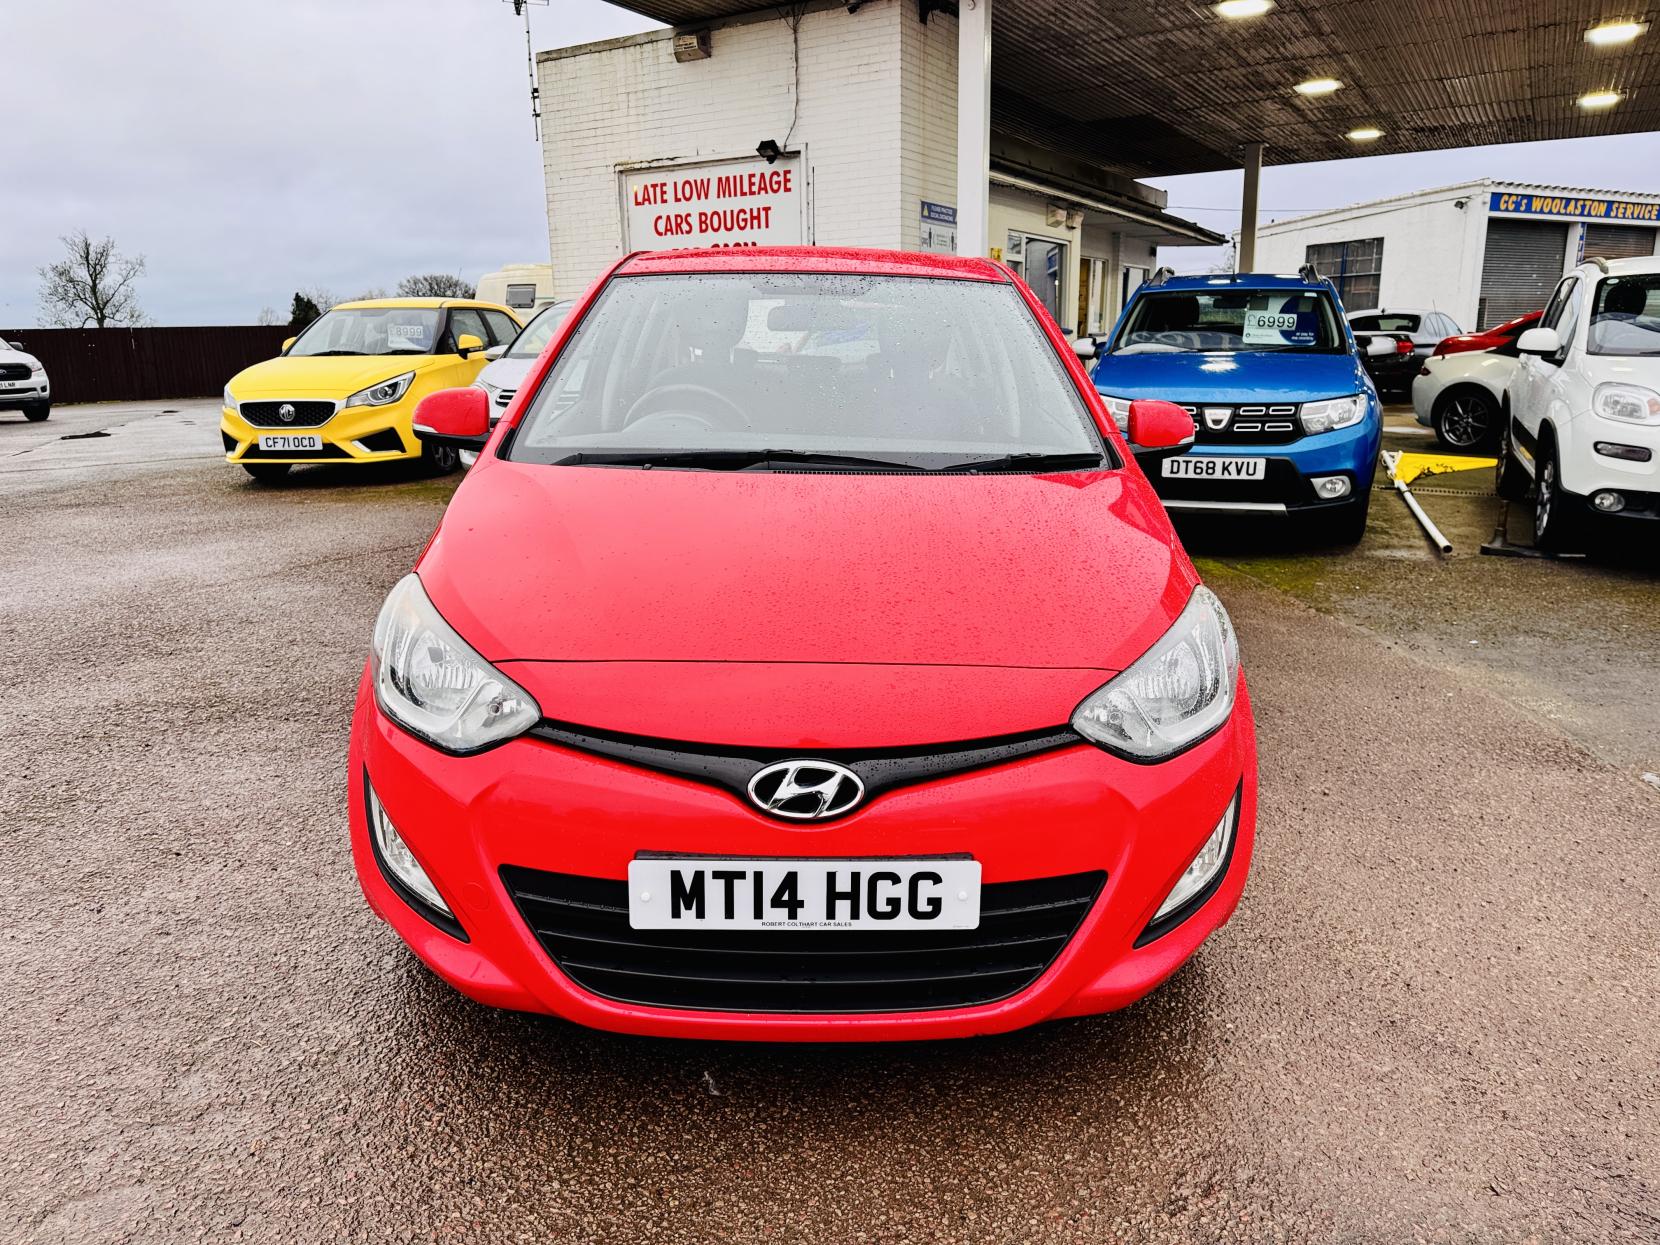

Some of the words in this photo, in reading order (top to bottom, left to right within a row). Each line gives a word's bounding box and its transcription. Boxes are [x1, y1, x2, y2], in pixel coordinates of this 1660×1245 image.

[634, 182, 668, 206] LATE
[673, 178, 711, 203] LOW
[717, 169, 792, 199] MILEAGE
[654, 213, 693, 237] CARS
[698, 206, 772, 234] BOUGHT
[1532, 196, 1607, 217] WOOLASTON
[1611, 202, 1659, 220] SERVICE
[265, 437, 290, 448] CF71
[293, 437, 316, 448] OCD
[1169, 460, 1216, 475] DT68
[1221, 461, 1257, 476] KVU
[670, 870, 804, 920] MT14
[826, 871, 943, 921] HGG
